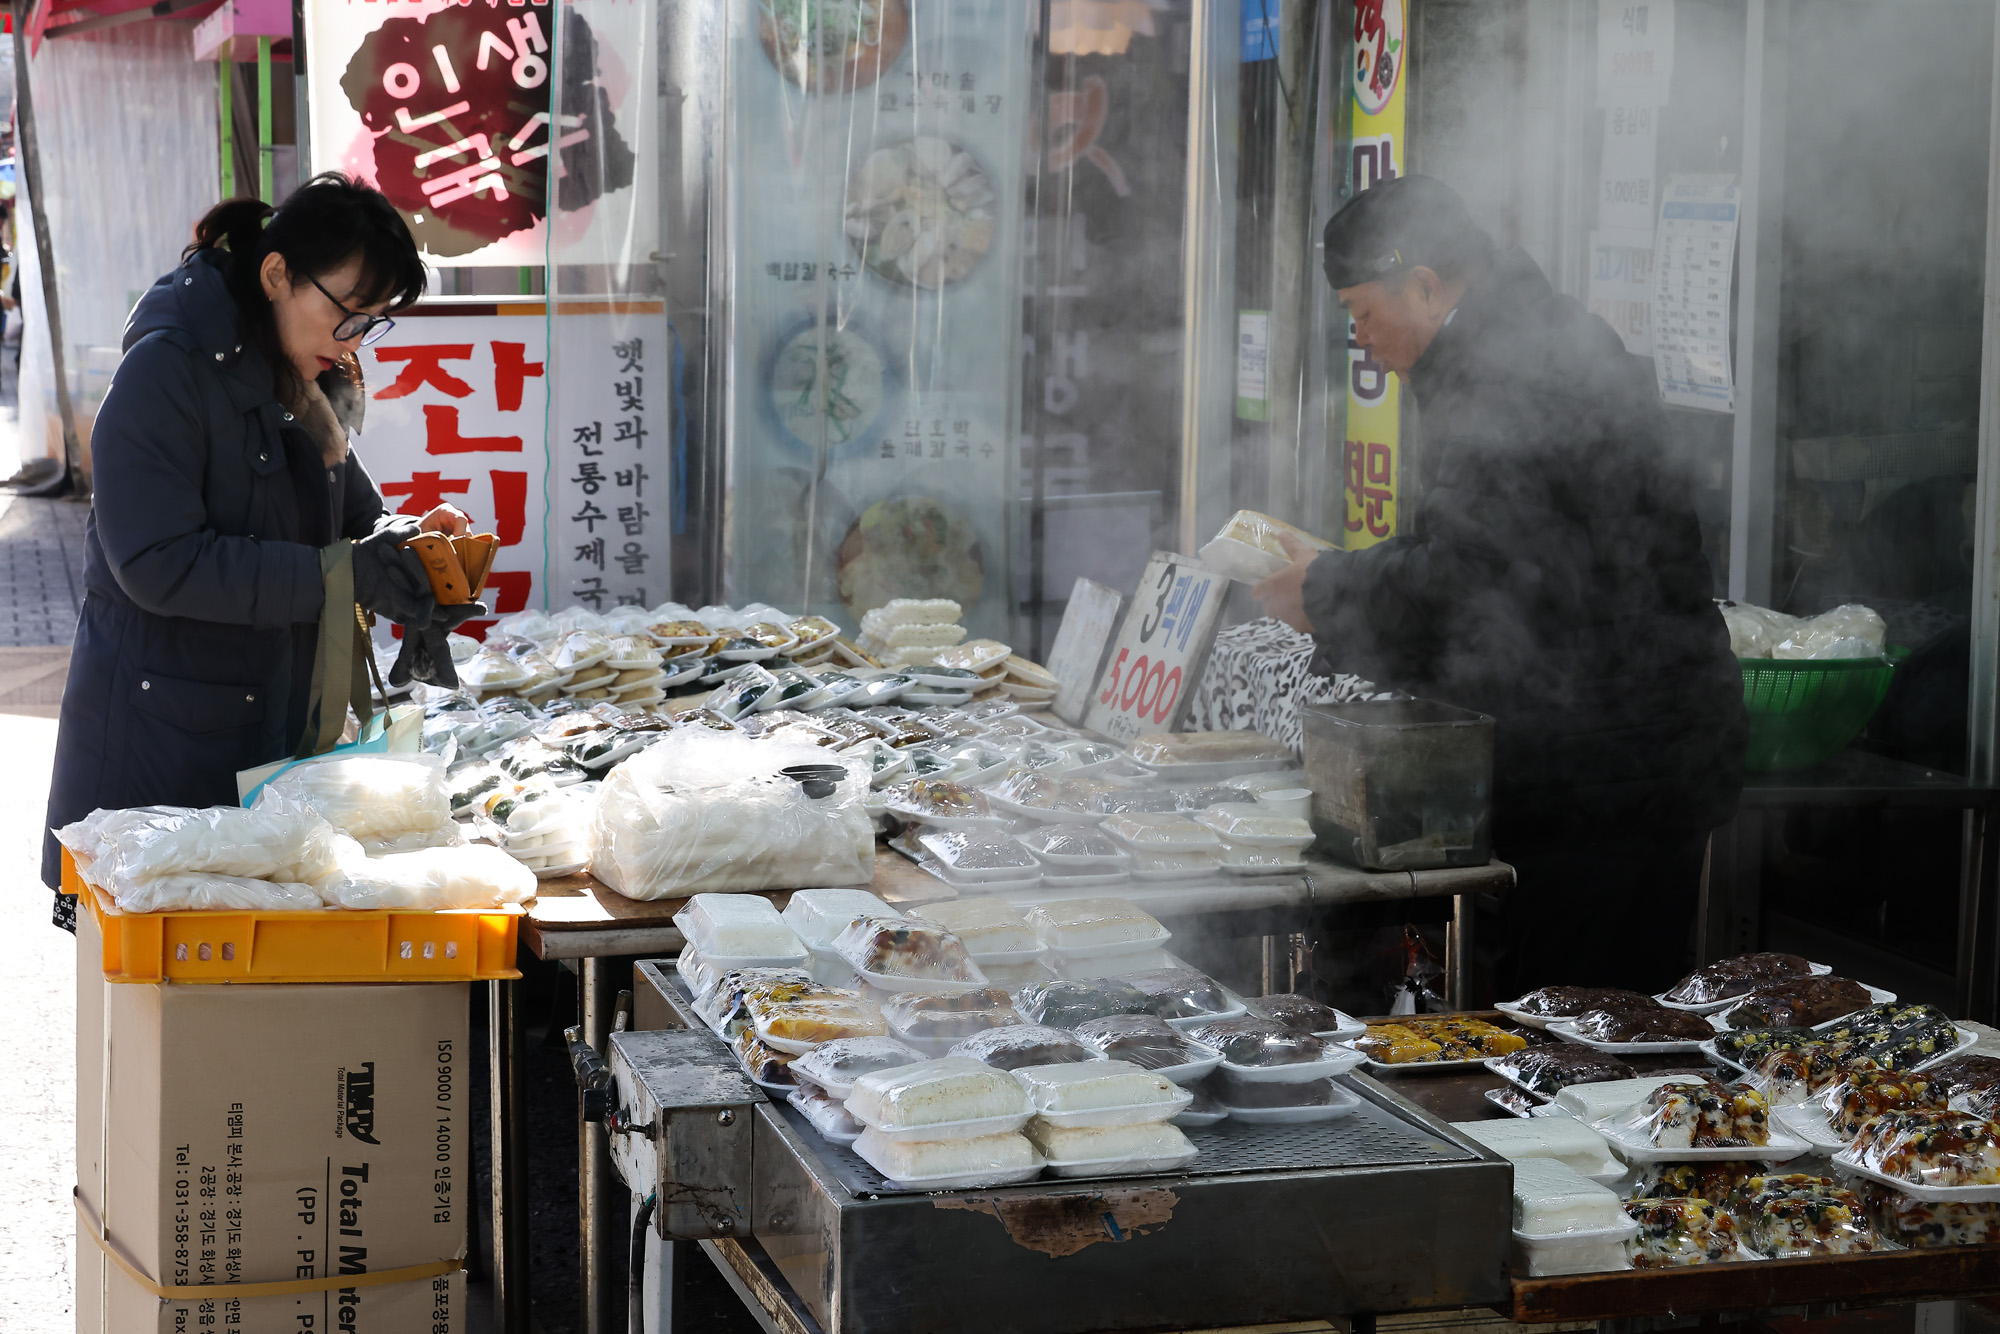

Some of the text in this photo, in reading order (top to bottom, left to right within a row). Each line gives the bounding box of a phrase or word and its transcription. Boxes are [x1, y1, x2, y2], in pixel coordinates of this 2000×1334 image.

[381, 10, 549, 135] 인생
[1612, 106, 1652, 136] 옹심이
[413, 111, 591, 210] 국수
[1604, 178, 1651, 207] 5,000원
[612, 338, 649, 450] 햇빛과
[613, 463, 650, 576] 바람을
[1100, 648, 1182, 725] 5,000
[227, 1102, 244, 1139] 티엠피
[335, 1066, 346, 1139] Total Material Package
[436, 1116, 451, 1162] 14000
[339, 1162, 370, 1237] Total
[433, 1166, 451, 1224] 인증기업
[174, 1179, 189, 1286] 031-358-8753
[200, 1209, 216, 1246] 경기도
[225, 1208, 243, 1245] 경기도
[199, 1249, 216, 1285] 화성시
[225, 1248, 243, 1284] 화성시
[296, 1249, 315, 1280] PE
[198, 1298, 215, 1327] 정읍
[224, 1296, 242, 1325] 안면
[432, 1275, 451, 1334] 품포장용
